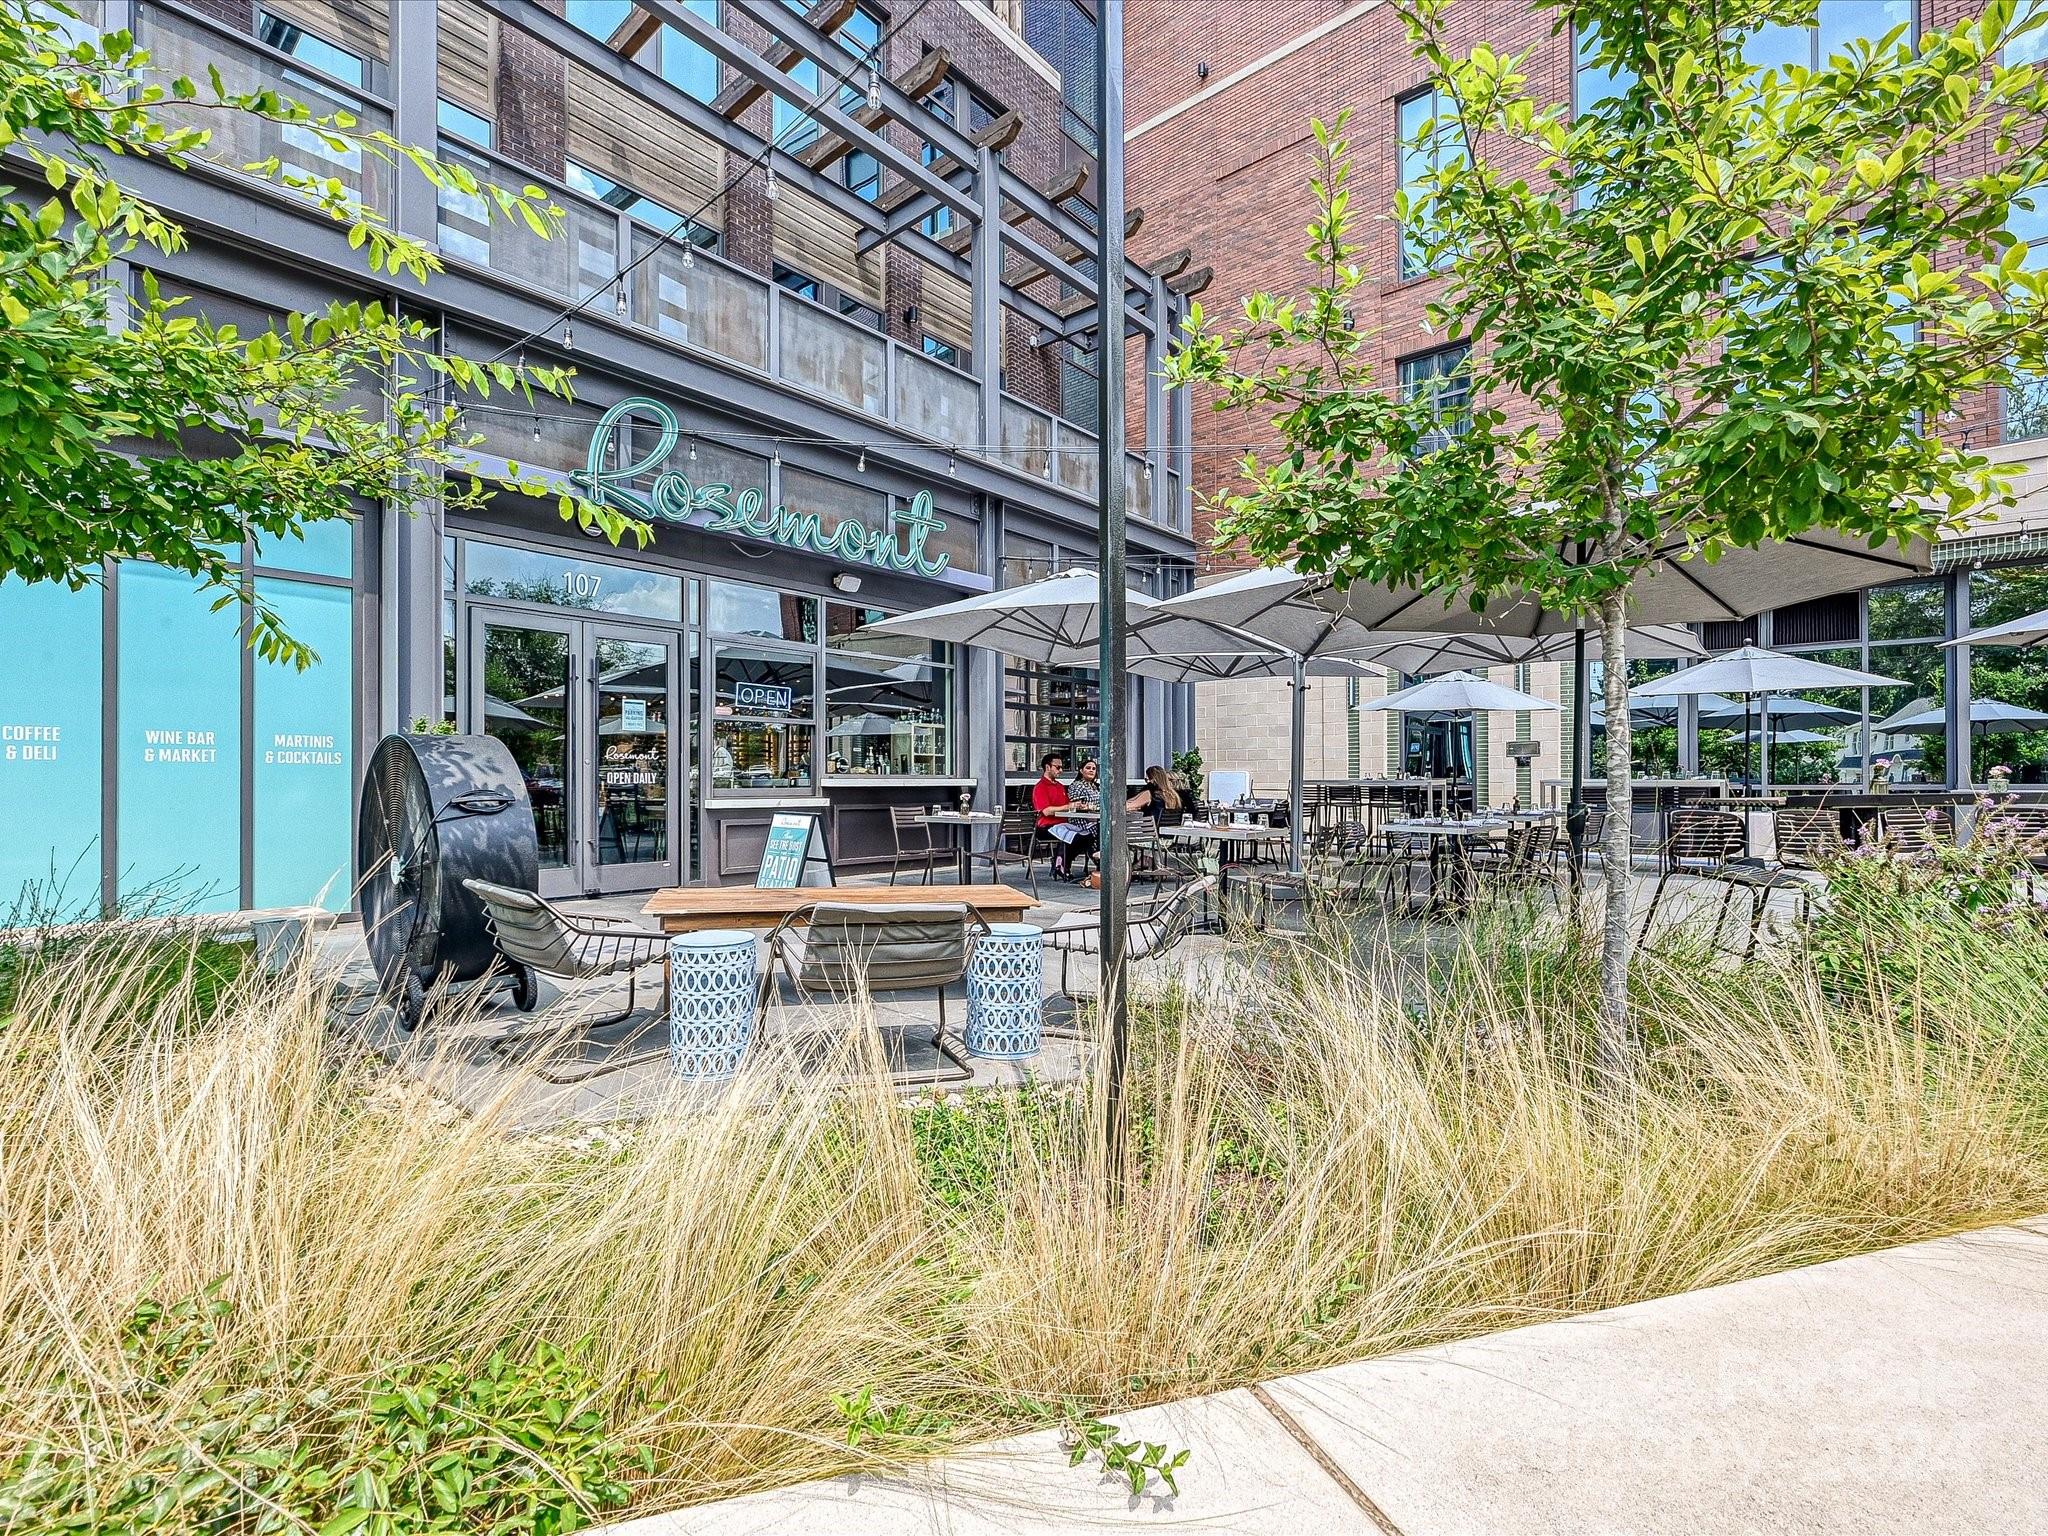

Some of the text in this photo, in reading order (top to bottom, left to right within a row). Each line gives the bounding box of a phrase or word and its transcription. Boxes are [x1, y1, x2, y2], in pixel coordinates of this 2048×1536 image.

[568, 396, 951, 578] Rosemont
[563, 571, 602, 597] 107
[740, 687, 788, 707] OPEN
[2, 725, 61, 742] COFFEE
[145, 730, 216, 746] WINE BAR
[274, 734, 334, 748] MARTINIS
[5, 745, 57, 761] & DELI
[144, 748, 217, 763] & MARKET
[265, 751, 342, 765] & COCKTAILS
[604, 745, 660, 761] Rosemont
[606, 772, 657, 785] OPEN DAILY
[761, 854, 799, 881] PATIO
